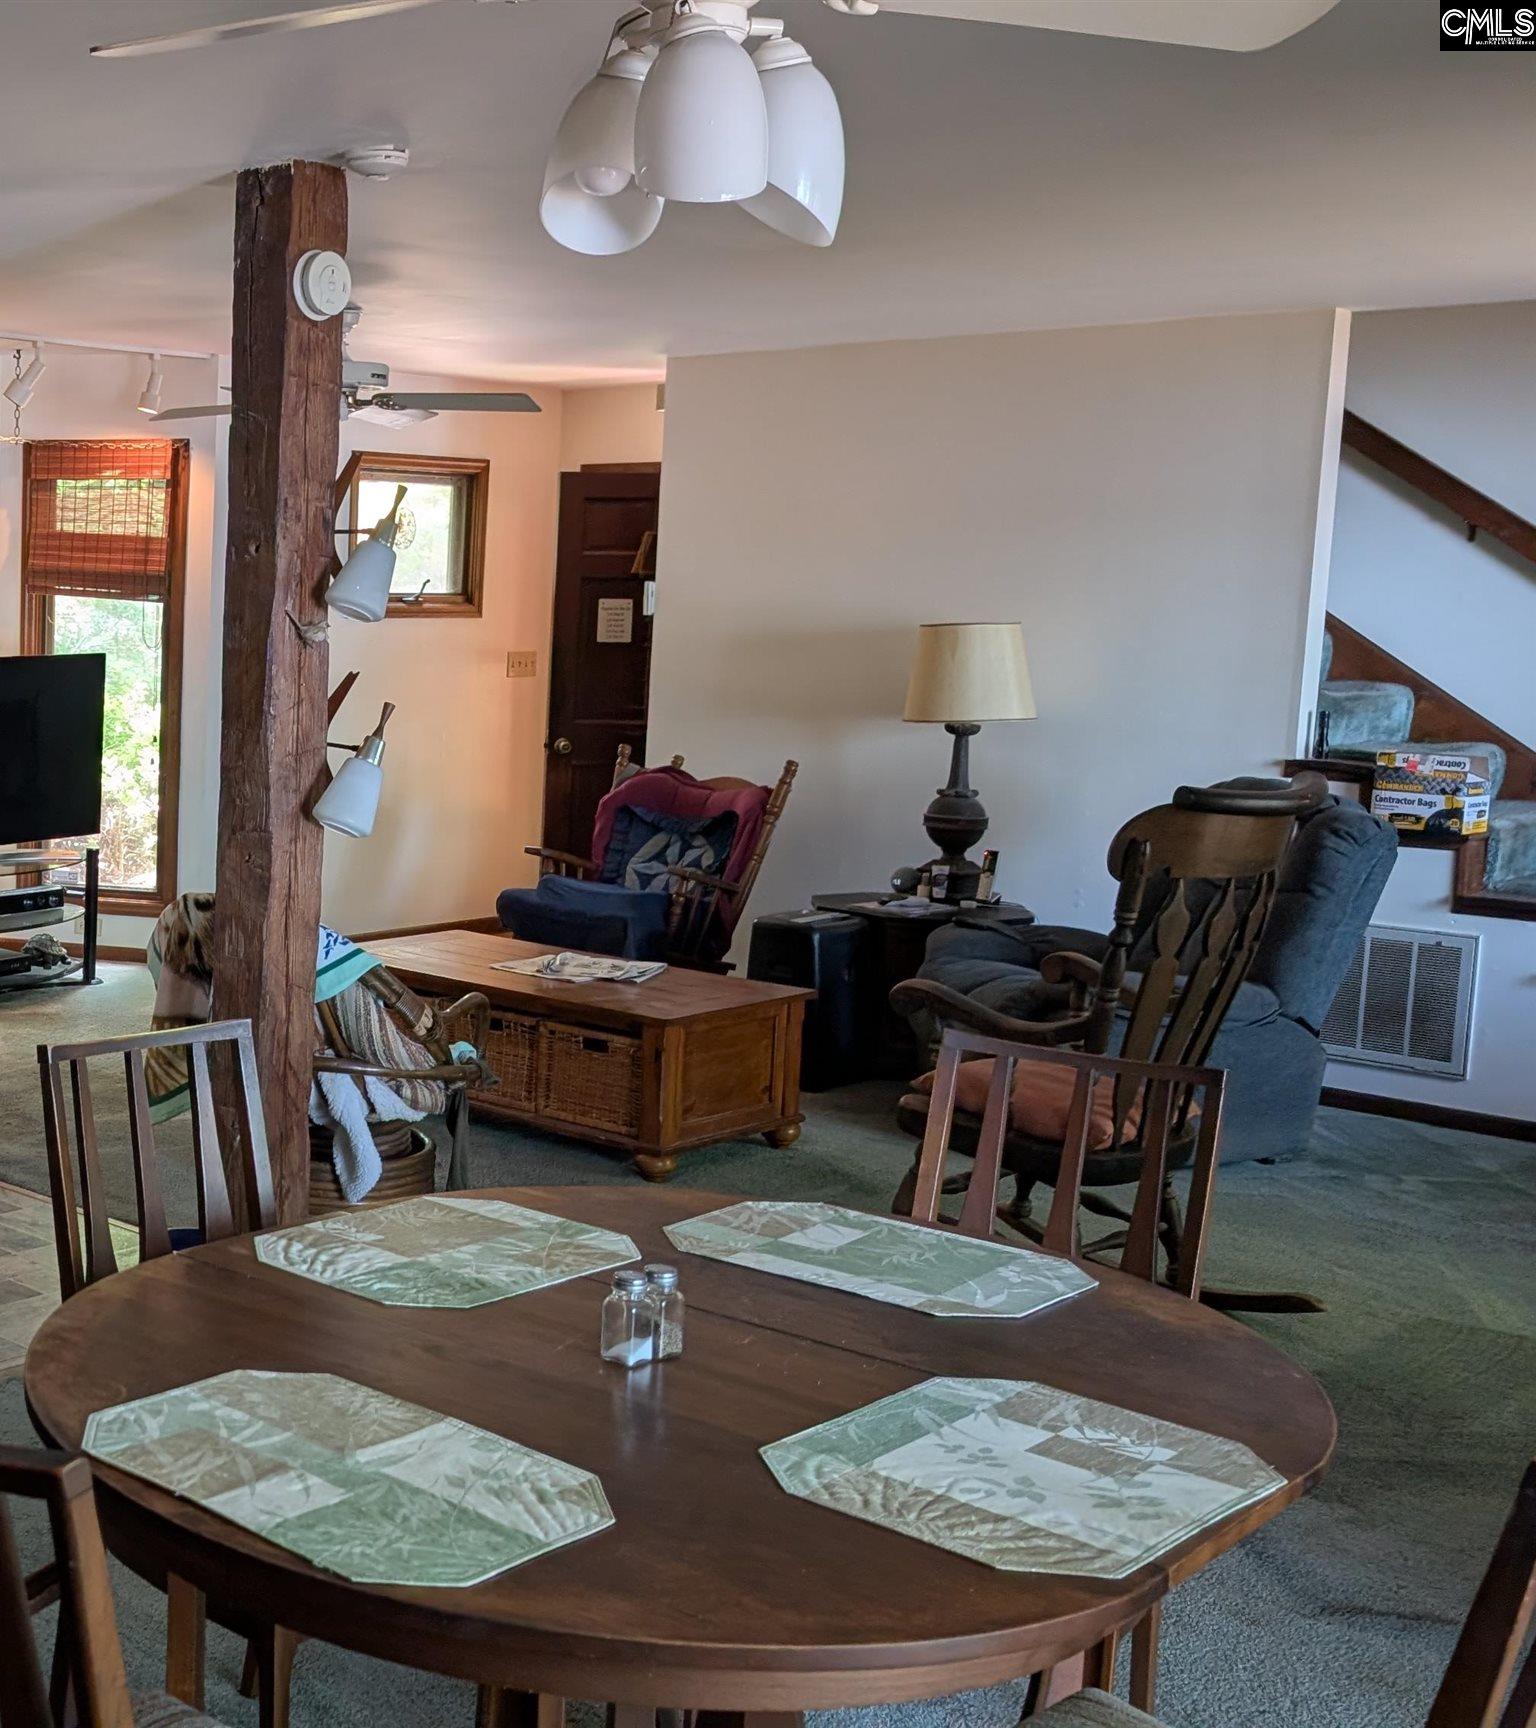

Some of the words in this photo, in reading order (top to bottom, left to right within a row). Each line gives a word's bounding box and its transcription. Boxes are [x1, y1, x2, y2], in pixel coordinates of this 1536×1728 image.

[1436, 759, 1467, 770] Contrac
[1375, 795, 1416, 805] Contractor
[1417, 797, 1437, 810] Bags
